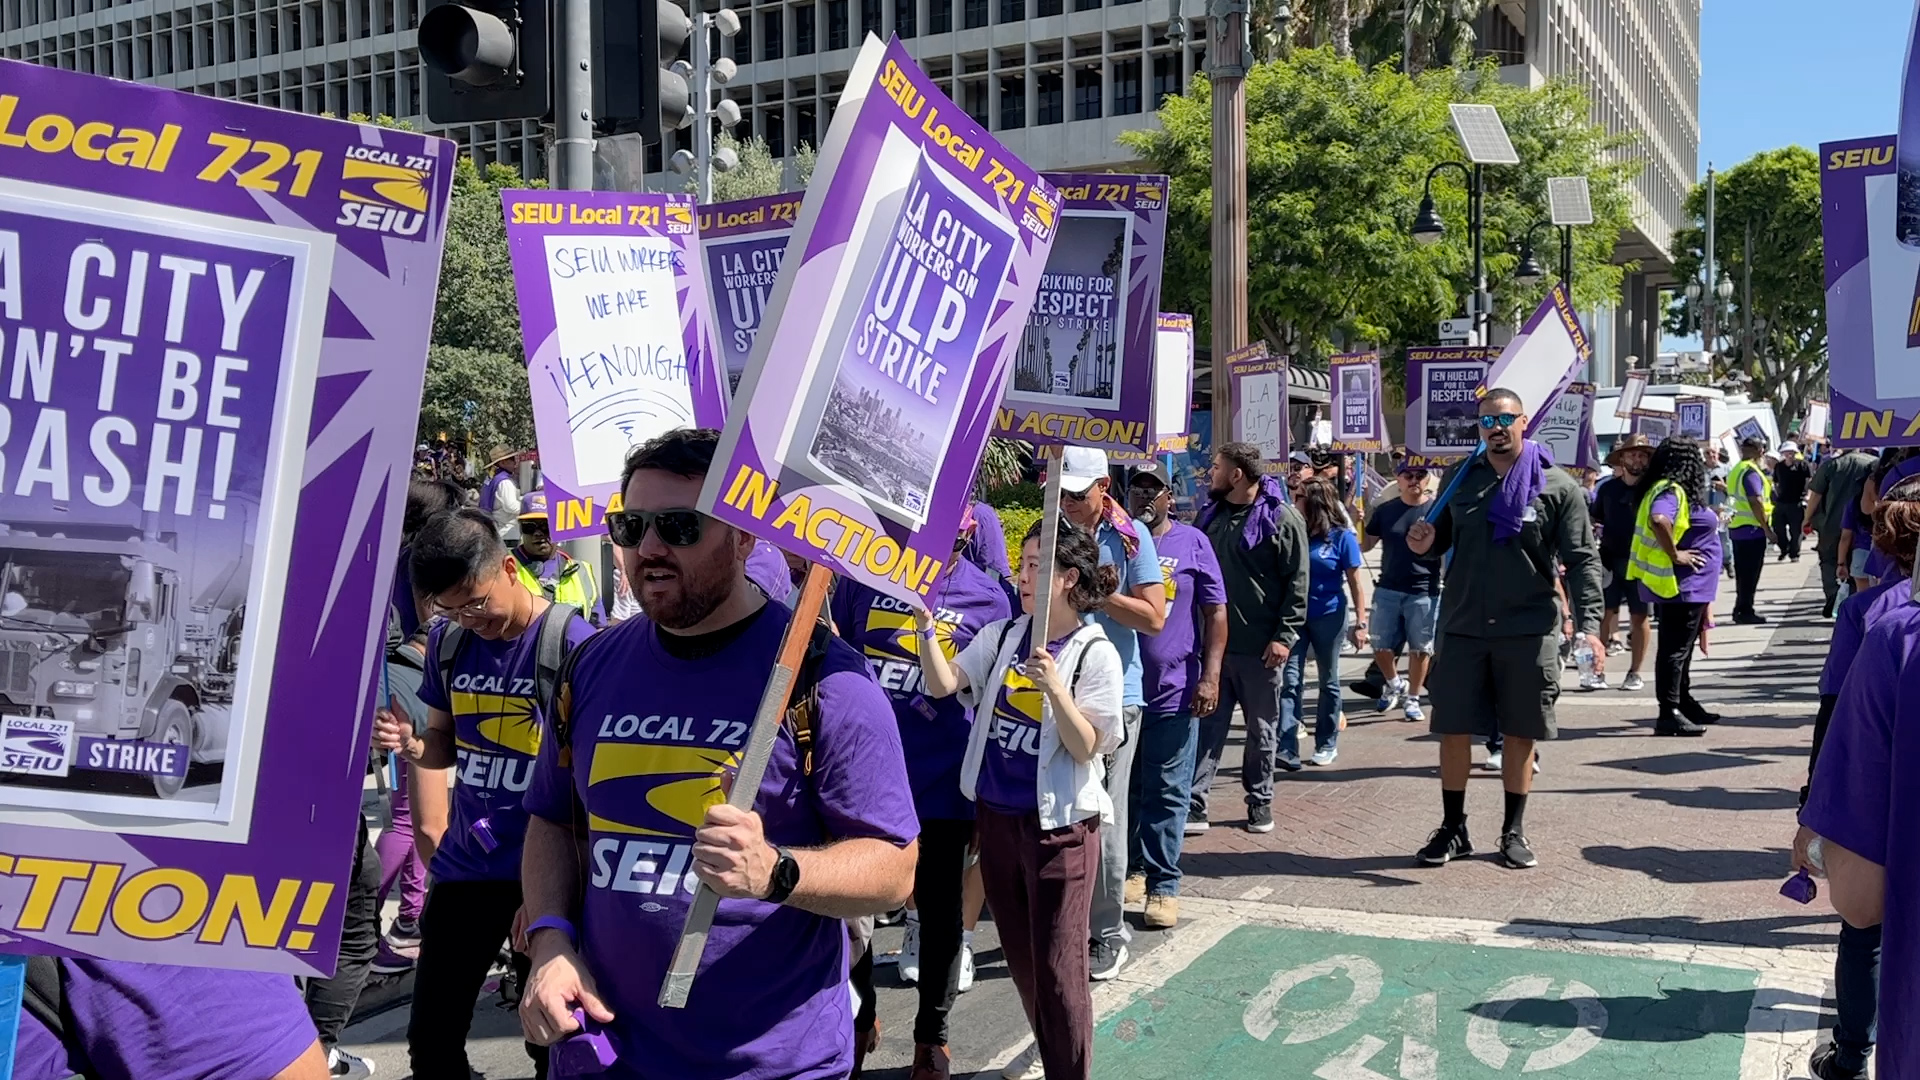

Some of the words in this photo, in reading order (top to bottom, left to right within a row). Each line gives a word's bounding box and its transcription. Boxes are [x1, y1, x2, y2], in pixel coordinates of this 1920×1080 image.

[0, 95, 183, 172] Local
[197, 132, 323, 197] 721
[878, 59, 927, 119] SEIU
[920, 106, 986, 172] Local
[981, 157, 1026, 205] 721
[345, 146, 401, 166] LOCAL
[404, 156, 433, 171] 721
[1827, 146, 1895, 170] SEIU
[1057, 183, 1091, 201] ocal
[1094, 184, 1131, 202] 721
[1134, 200, 1161, 210] SEIU
[336, 202, 425, 235] SEIU
[511, 202, 564, 225] SEIU
[569, 204, 622, 226] Local
[627, 205, 661, 226] 721
[717, 206, 765, 229] Local
[770, 201, 801, 221] 721
[905, 179, 931, 233] LA
[931, 209, 993, 274] CITY
[1020, 212, 1050, 240] SEIU
[667, 224, 692, 234] SEIU
[554, 246, 614, 279] SEIU
[721, 252, 747, 276] LA
[751, 247, 787, 274] CIT
[896, 215, 955, 282] WORKERS
[955, 268, 980, 300] ON
[63, 242, 265, 352] CITY
[1040, 274, 1084, 292] RIKING
[1088, 277, 1114, 293] FOR
[585, 293, 613, 320] WE
[616, 289, 650, 316] ARE
[875, 240, 967, 356] ULP
[1058, 317, 1109, 332] STRIKE
[857, 313, 949, 406] STRIKE
[1409, 351, 1434, 361] SEIU
[1436, 350, 1464, 360] Local
[1466, 350, 1485, 359] 721
[0, 325, 133, 412] N'T
[156, 348, 249, 429] BE
[1443, 382, 1457, 390] POR
[1447, 370, 1480, 381] HUELGA
[993, 407, 1016, 432] N
[1017, 411, 1146, 445] ACTION!
[1246, 432, 1258, 442] DO
[1840, 410, 1894, 439] IN
[1331, 441, 1344, 451] IN
[1345, 440, 1381, 450] ACTION!
[1408, 455, 1427, 467] IN
[556, 496, 594, 532] IN
[723, 463, 780, 521] IN
[771, 493, 943, 596] ACTION!
[1158, 556, 1179, 567] 721
[934, 607, 964, 624] 721
[451, 673, 504, 693] OCAL
[510, 678, 536, 695] 72
[7, 719, 45, 731] LOCAL
[49, 724, 68, 732] 721
[597, 714, 696, 742] LOCAL
[705, 719, 752, 746] 72
[2, 753, 63, 772] SEIU
[88, 742, 177, 774] STRIKE
[0, 854, 336, 951] TION!
